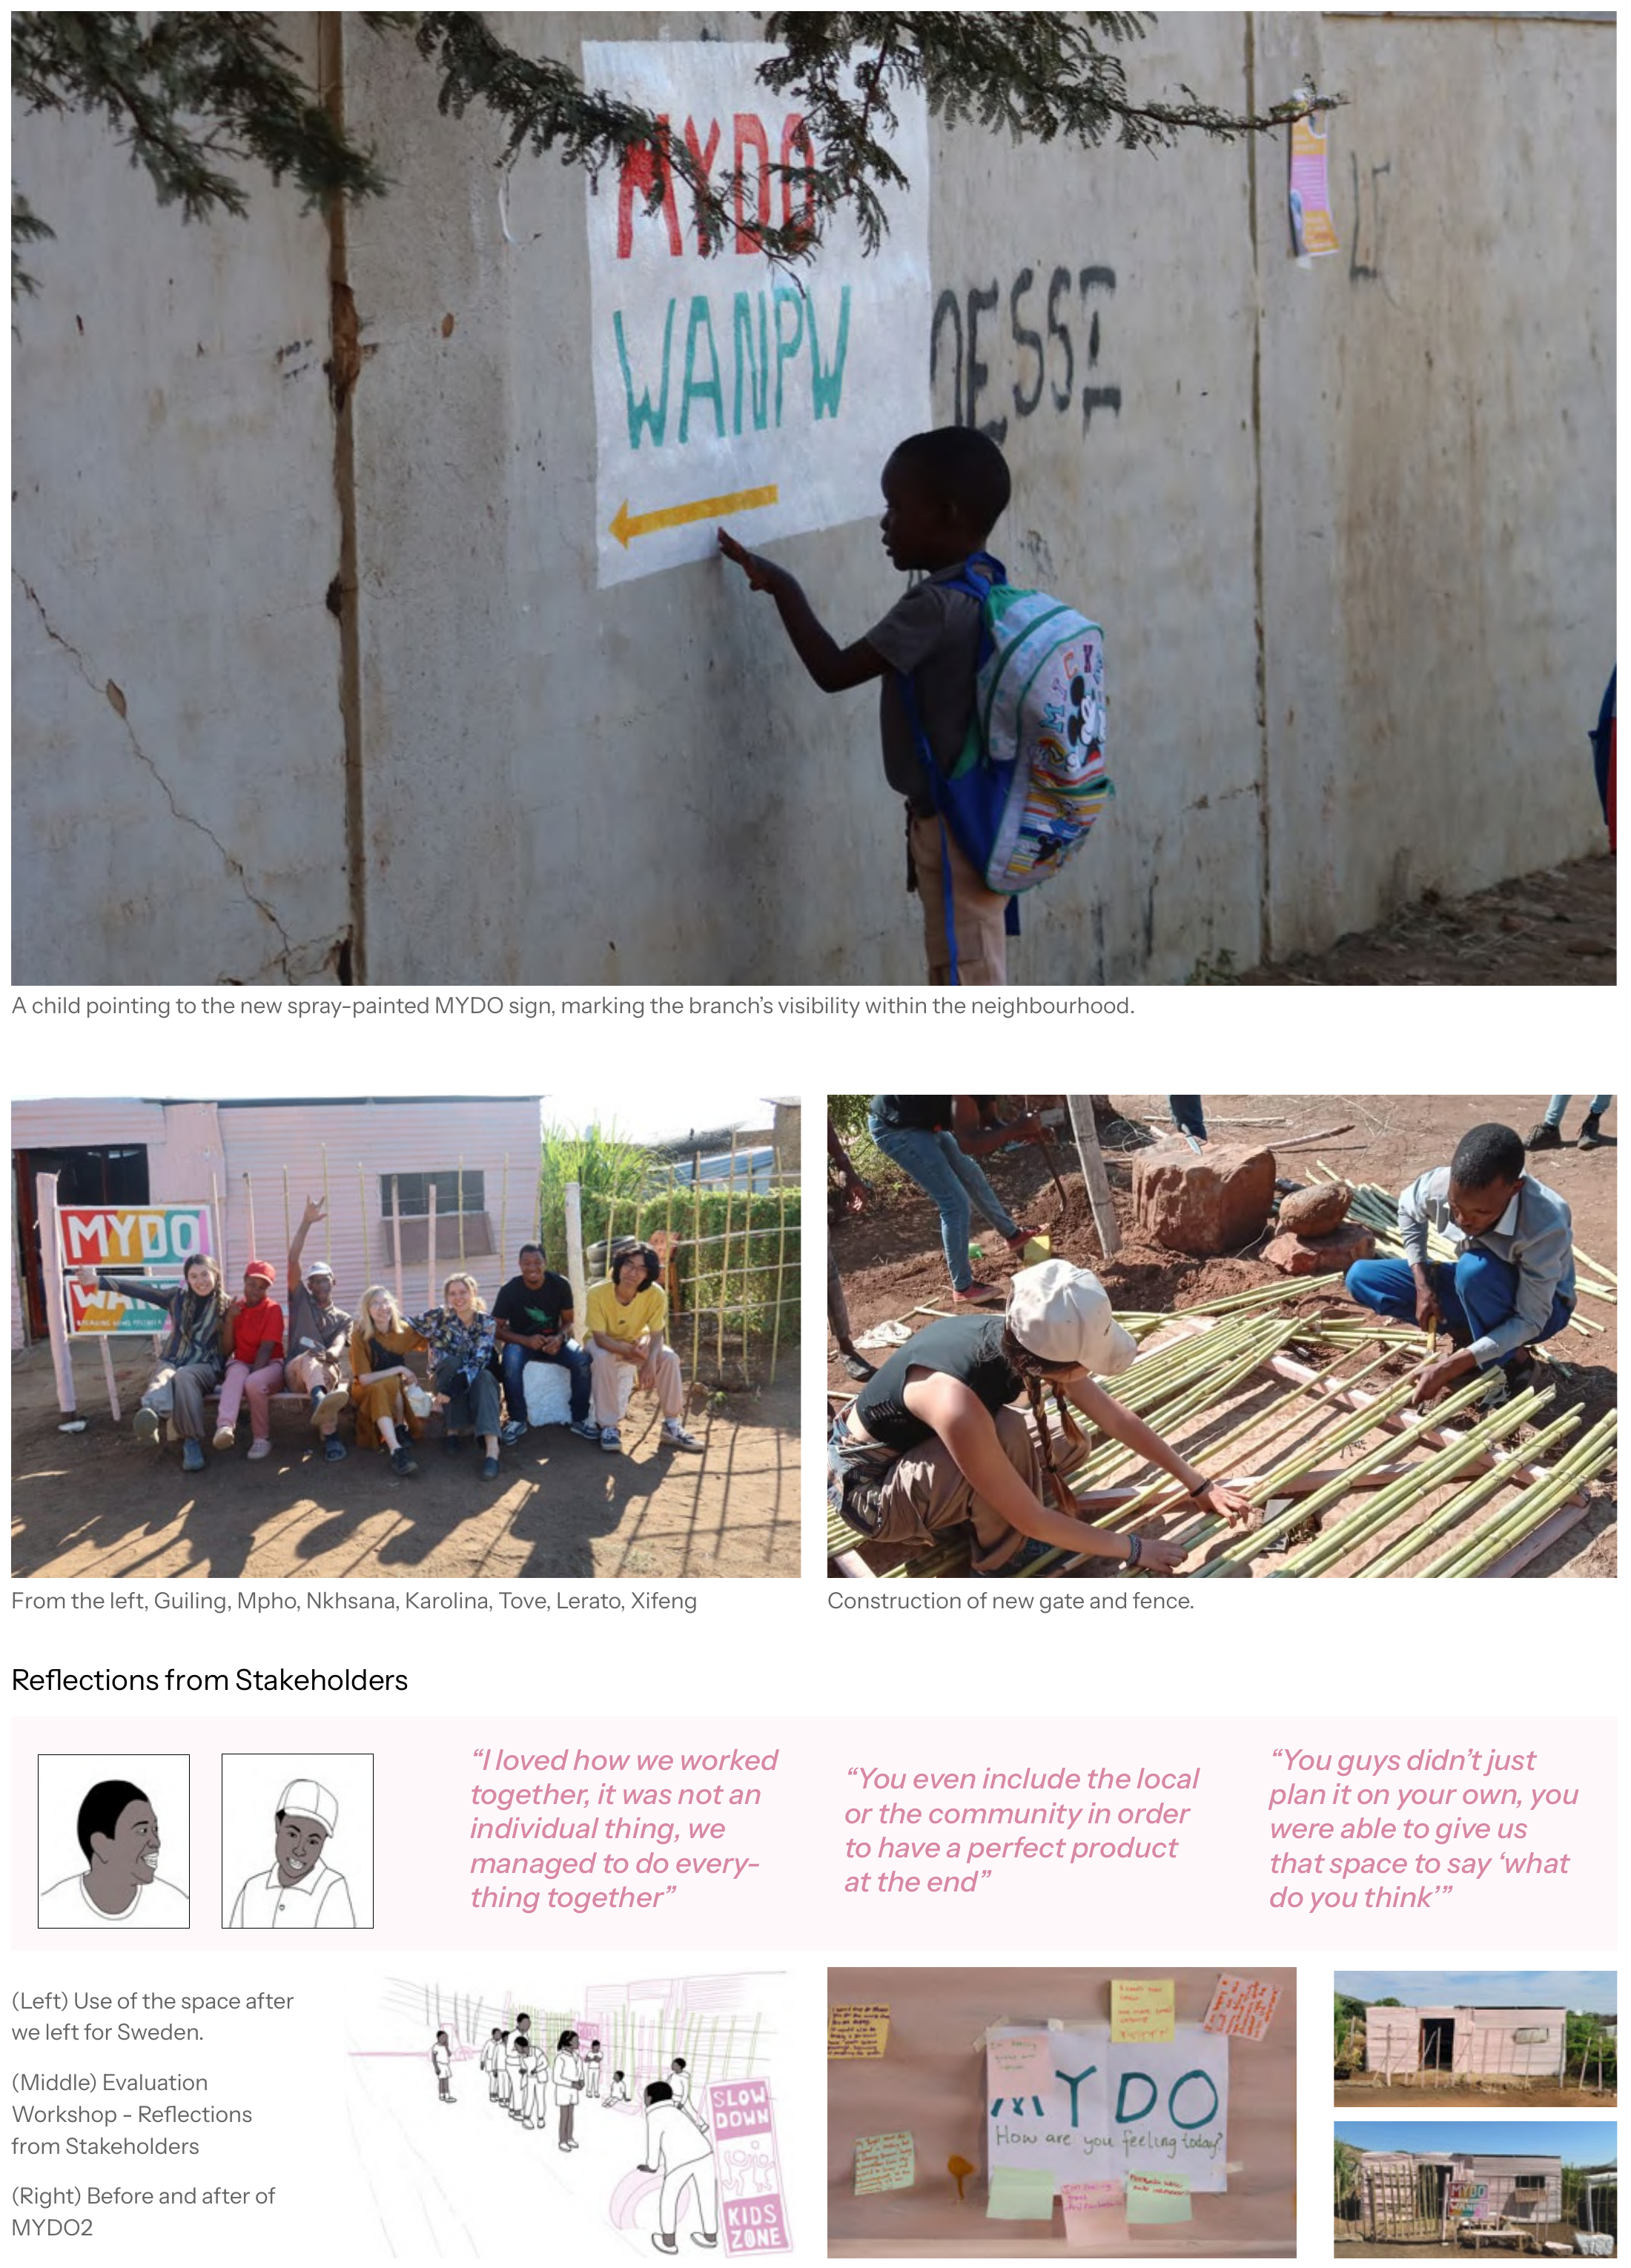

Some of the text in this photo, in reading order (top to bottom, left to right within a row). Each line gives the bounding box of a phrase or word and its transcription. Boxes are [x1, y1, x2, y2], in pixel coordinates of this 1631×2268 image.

[617, 113, 816, 259] MYDO
[613, 285, 850, 450] WANPW
[67, 1214, 200, 1259] MYDO
[713, 2086, 767, 2108] SLOW
[716, 2108, 770, 2129] DOWN
[996, 2125, 1224, 2160] How are you feeling today?
[728, 2204, 778, 2226] KIDS
[731, 2226, 781, 2249] ZONE
